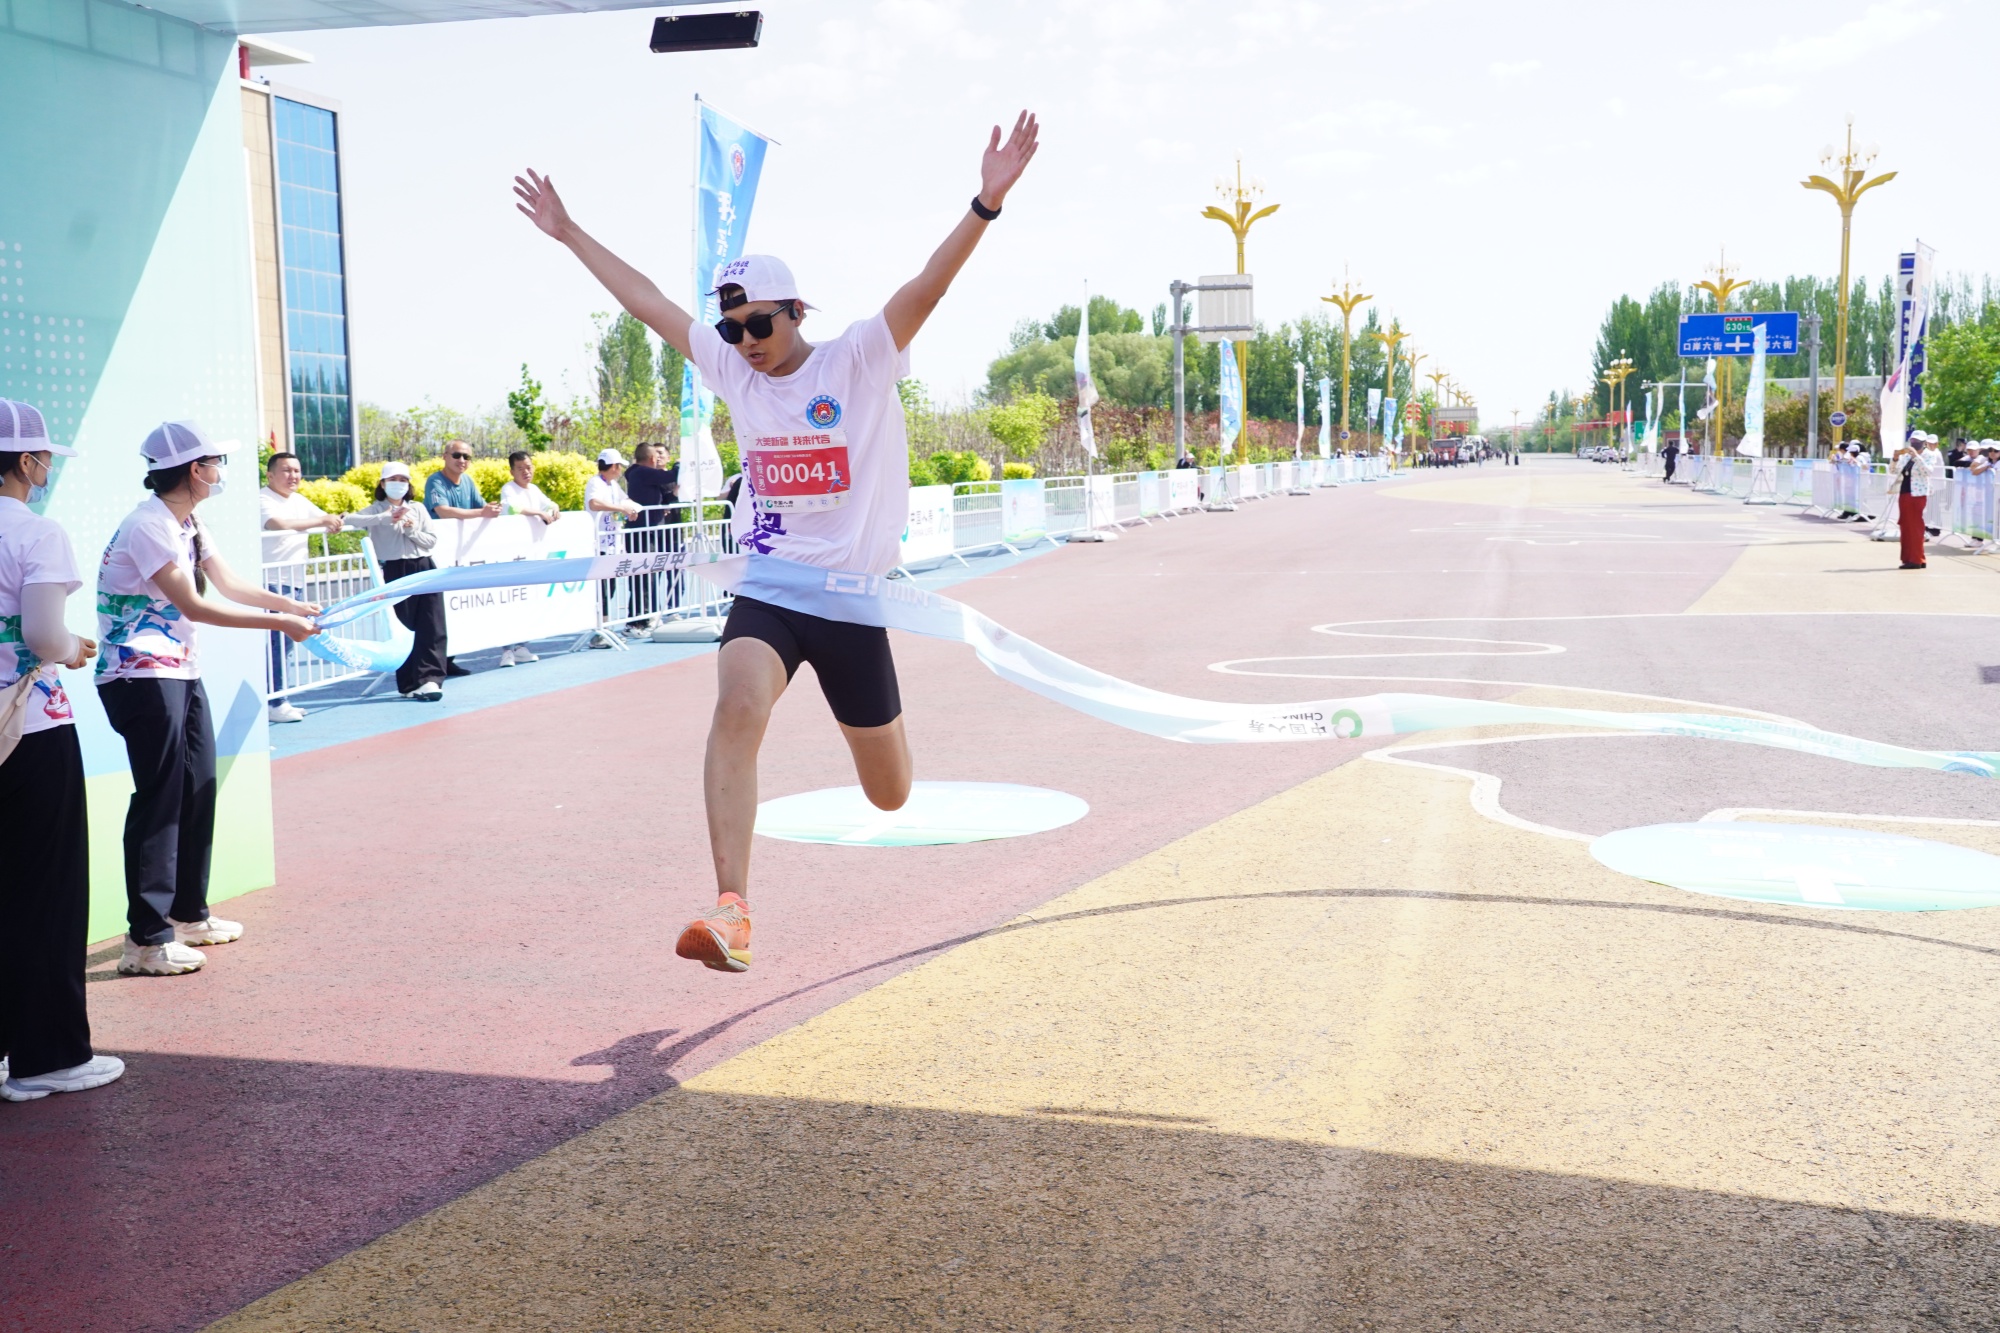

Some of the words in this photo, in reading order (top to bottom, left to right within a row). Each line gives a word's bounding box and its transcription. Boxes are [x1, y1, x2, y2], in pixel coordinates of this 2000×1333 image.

[755, 436, 788, 447] 大美新疆
[793, 434, 831, 446] 我来代言
[766, 461, 840, 484] 00041
[449, 592, 495, 611] CHINA
[499, 587, 527, 604] LIFE
